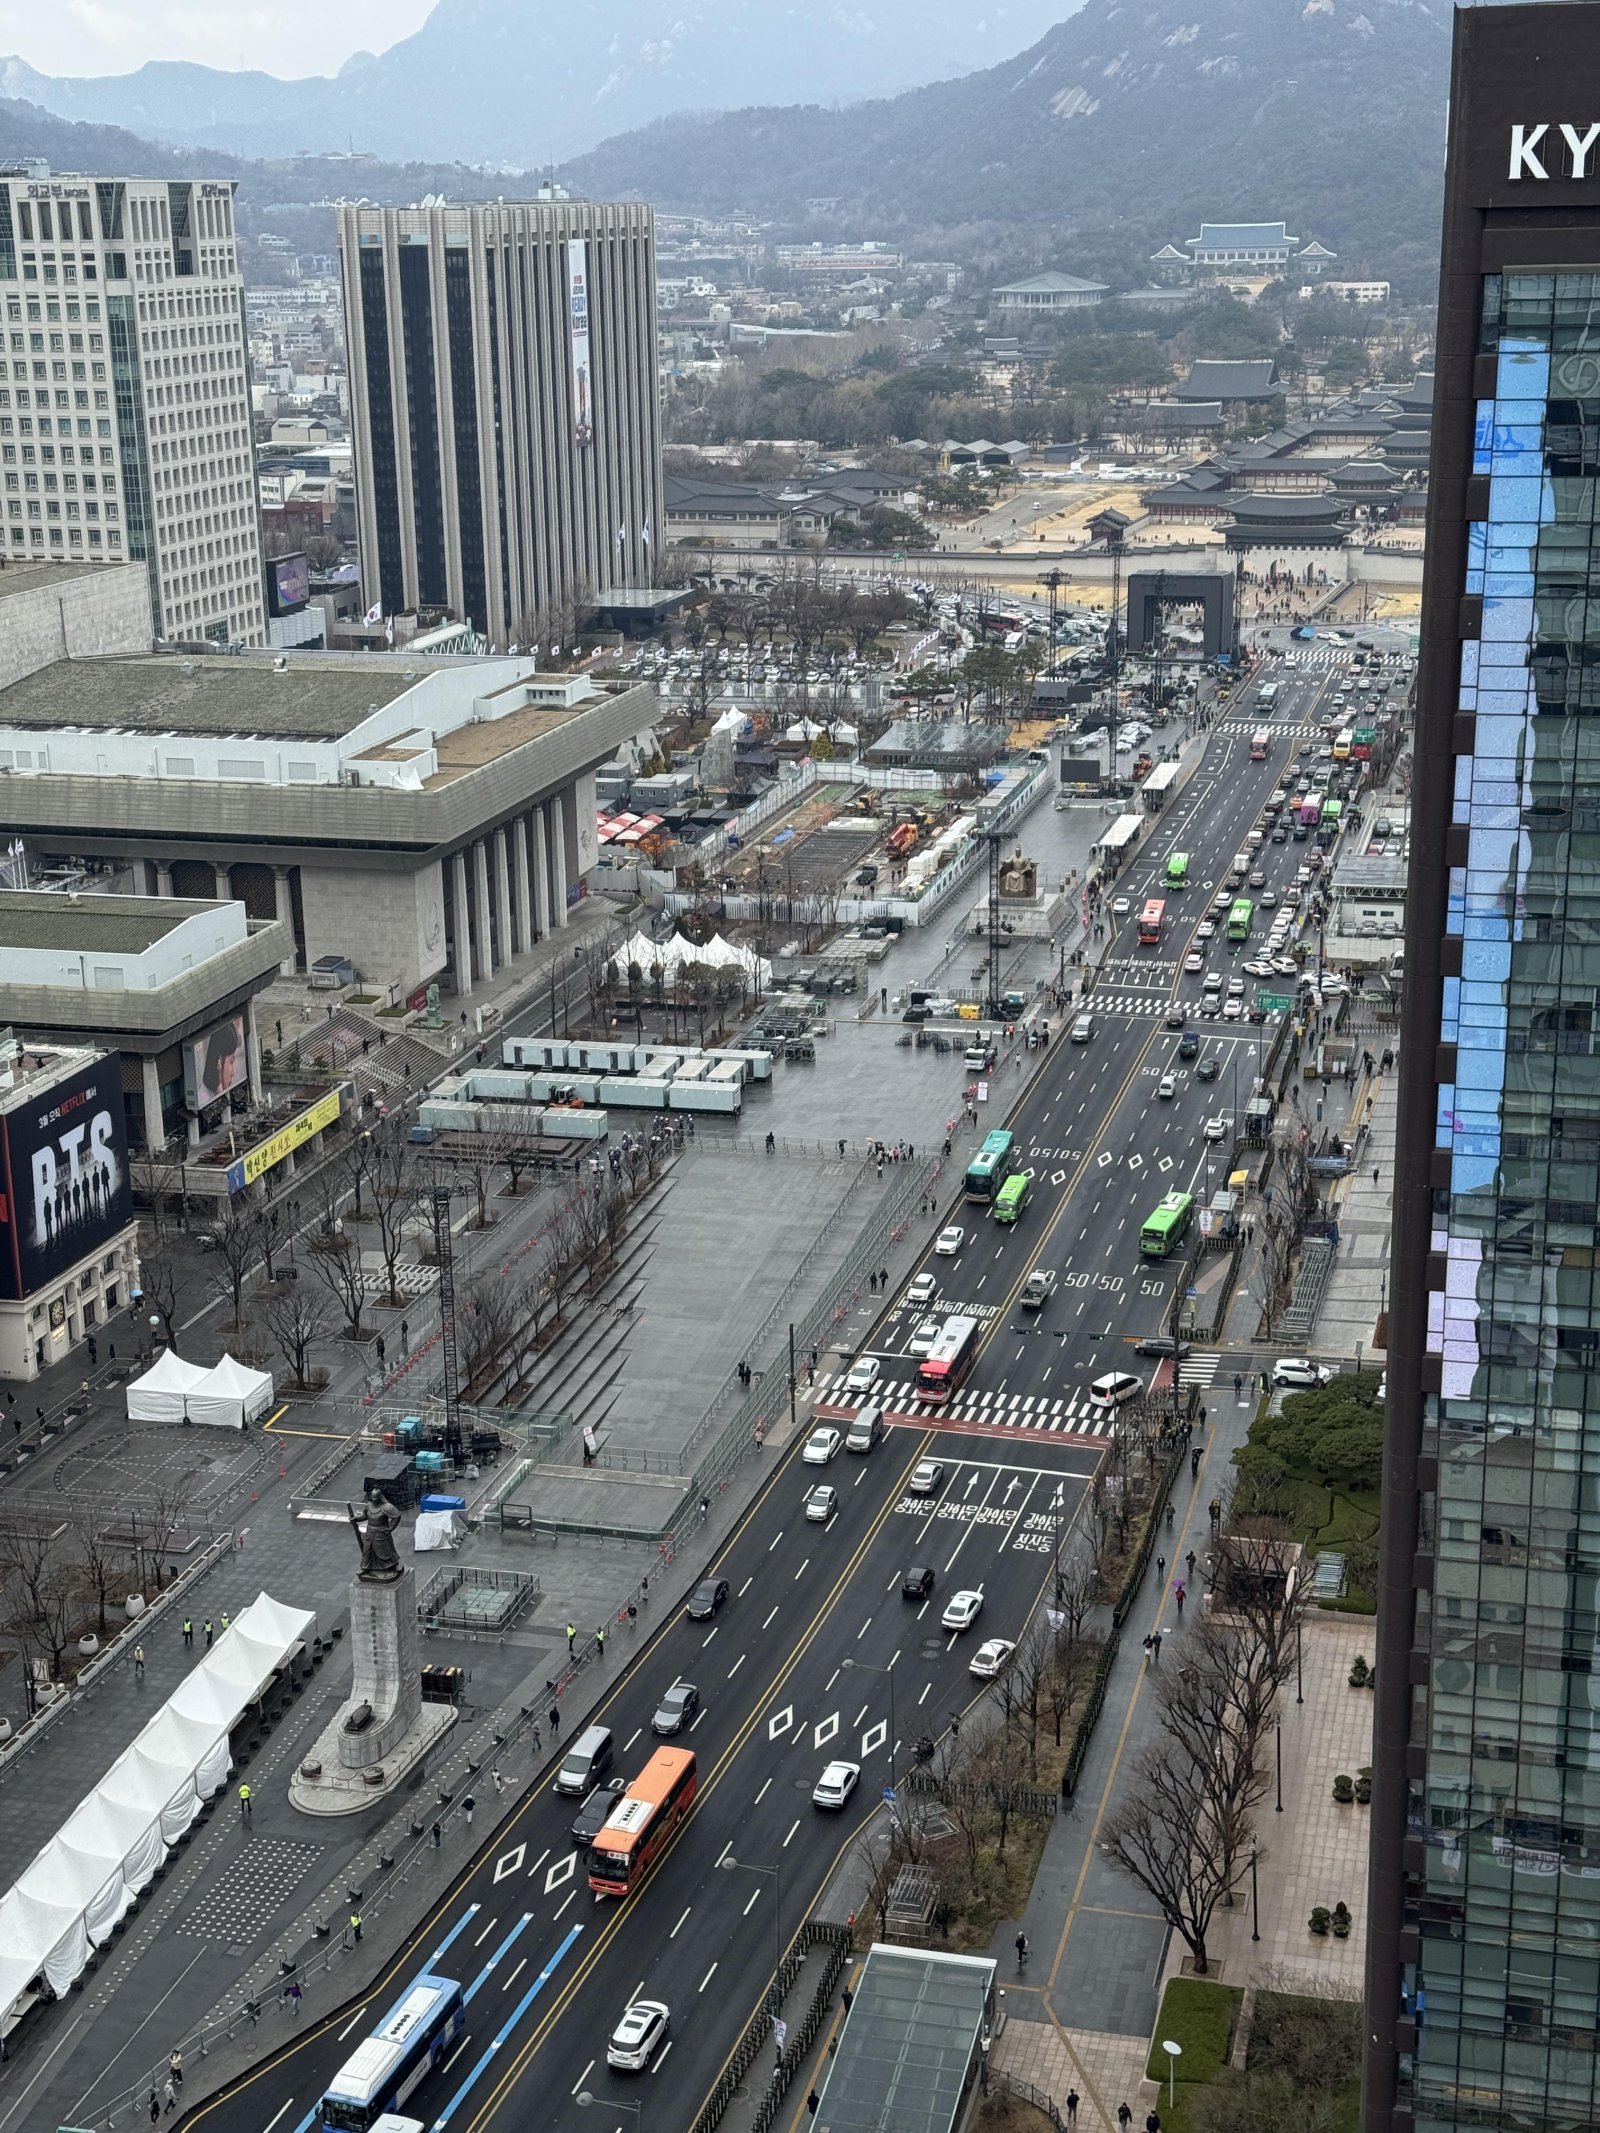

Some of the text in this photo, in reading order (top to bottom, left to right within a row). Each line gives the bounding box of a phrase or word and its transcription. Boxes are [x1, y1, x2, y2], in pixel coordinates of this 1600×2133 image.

[1508, 123, 1600, 179] KY
[27, 184, 89, 198] 외교부 MOFA
[1141, 1066, 1160, 1076] 50
[1169, 1069, 1188, 1079] 50
[38, 1114, 48, 1128] 3월
[49, 1107, 60, 1122] 오직
[1030, 1147, 1052, 1158] 50
[1060, 1150, 1081, 1160] 50
[247, 1149, 267, 1177] 박신양
[1065, 1272, 1089, 1287] 50
[1098, 1276, 1123, 1291] 50
[1140, 1280, 1164, 1296] 50
[894, 1497, 936, 1516] 광화문
[937, 1502, 978, 1521] 광화문
[976, 1507, 1018, 1526] 광화문
[1023, 1513, 1064, 1532] 광화문
[1012, 1533, 1055, 1553] 청진동
